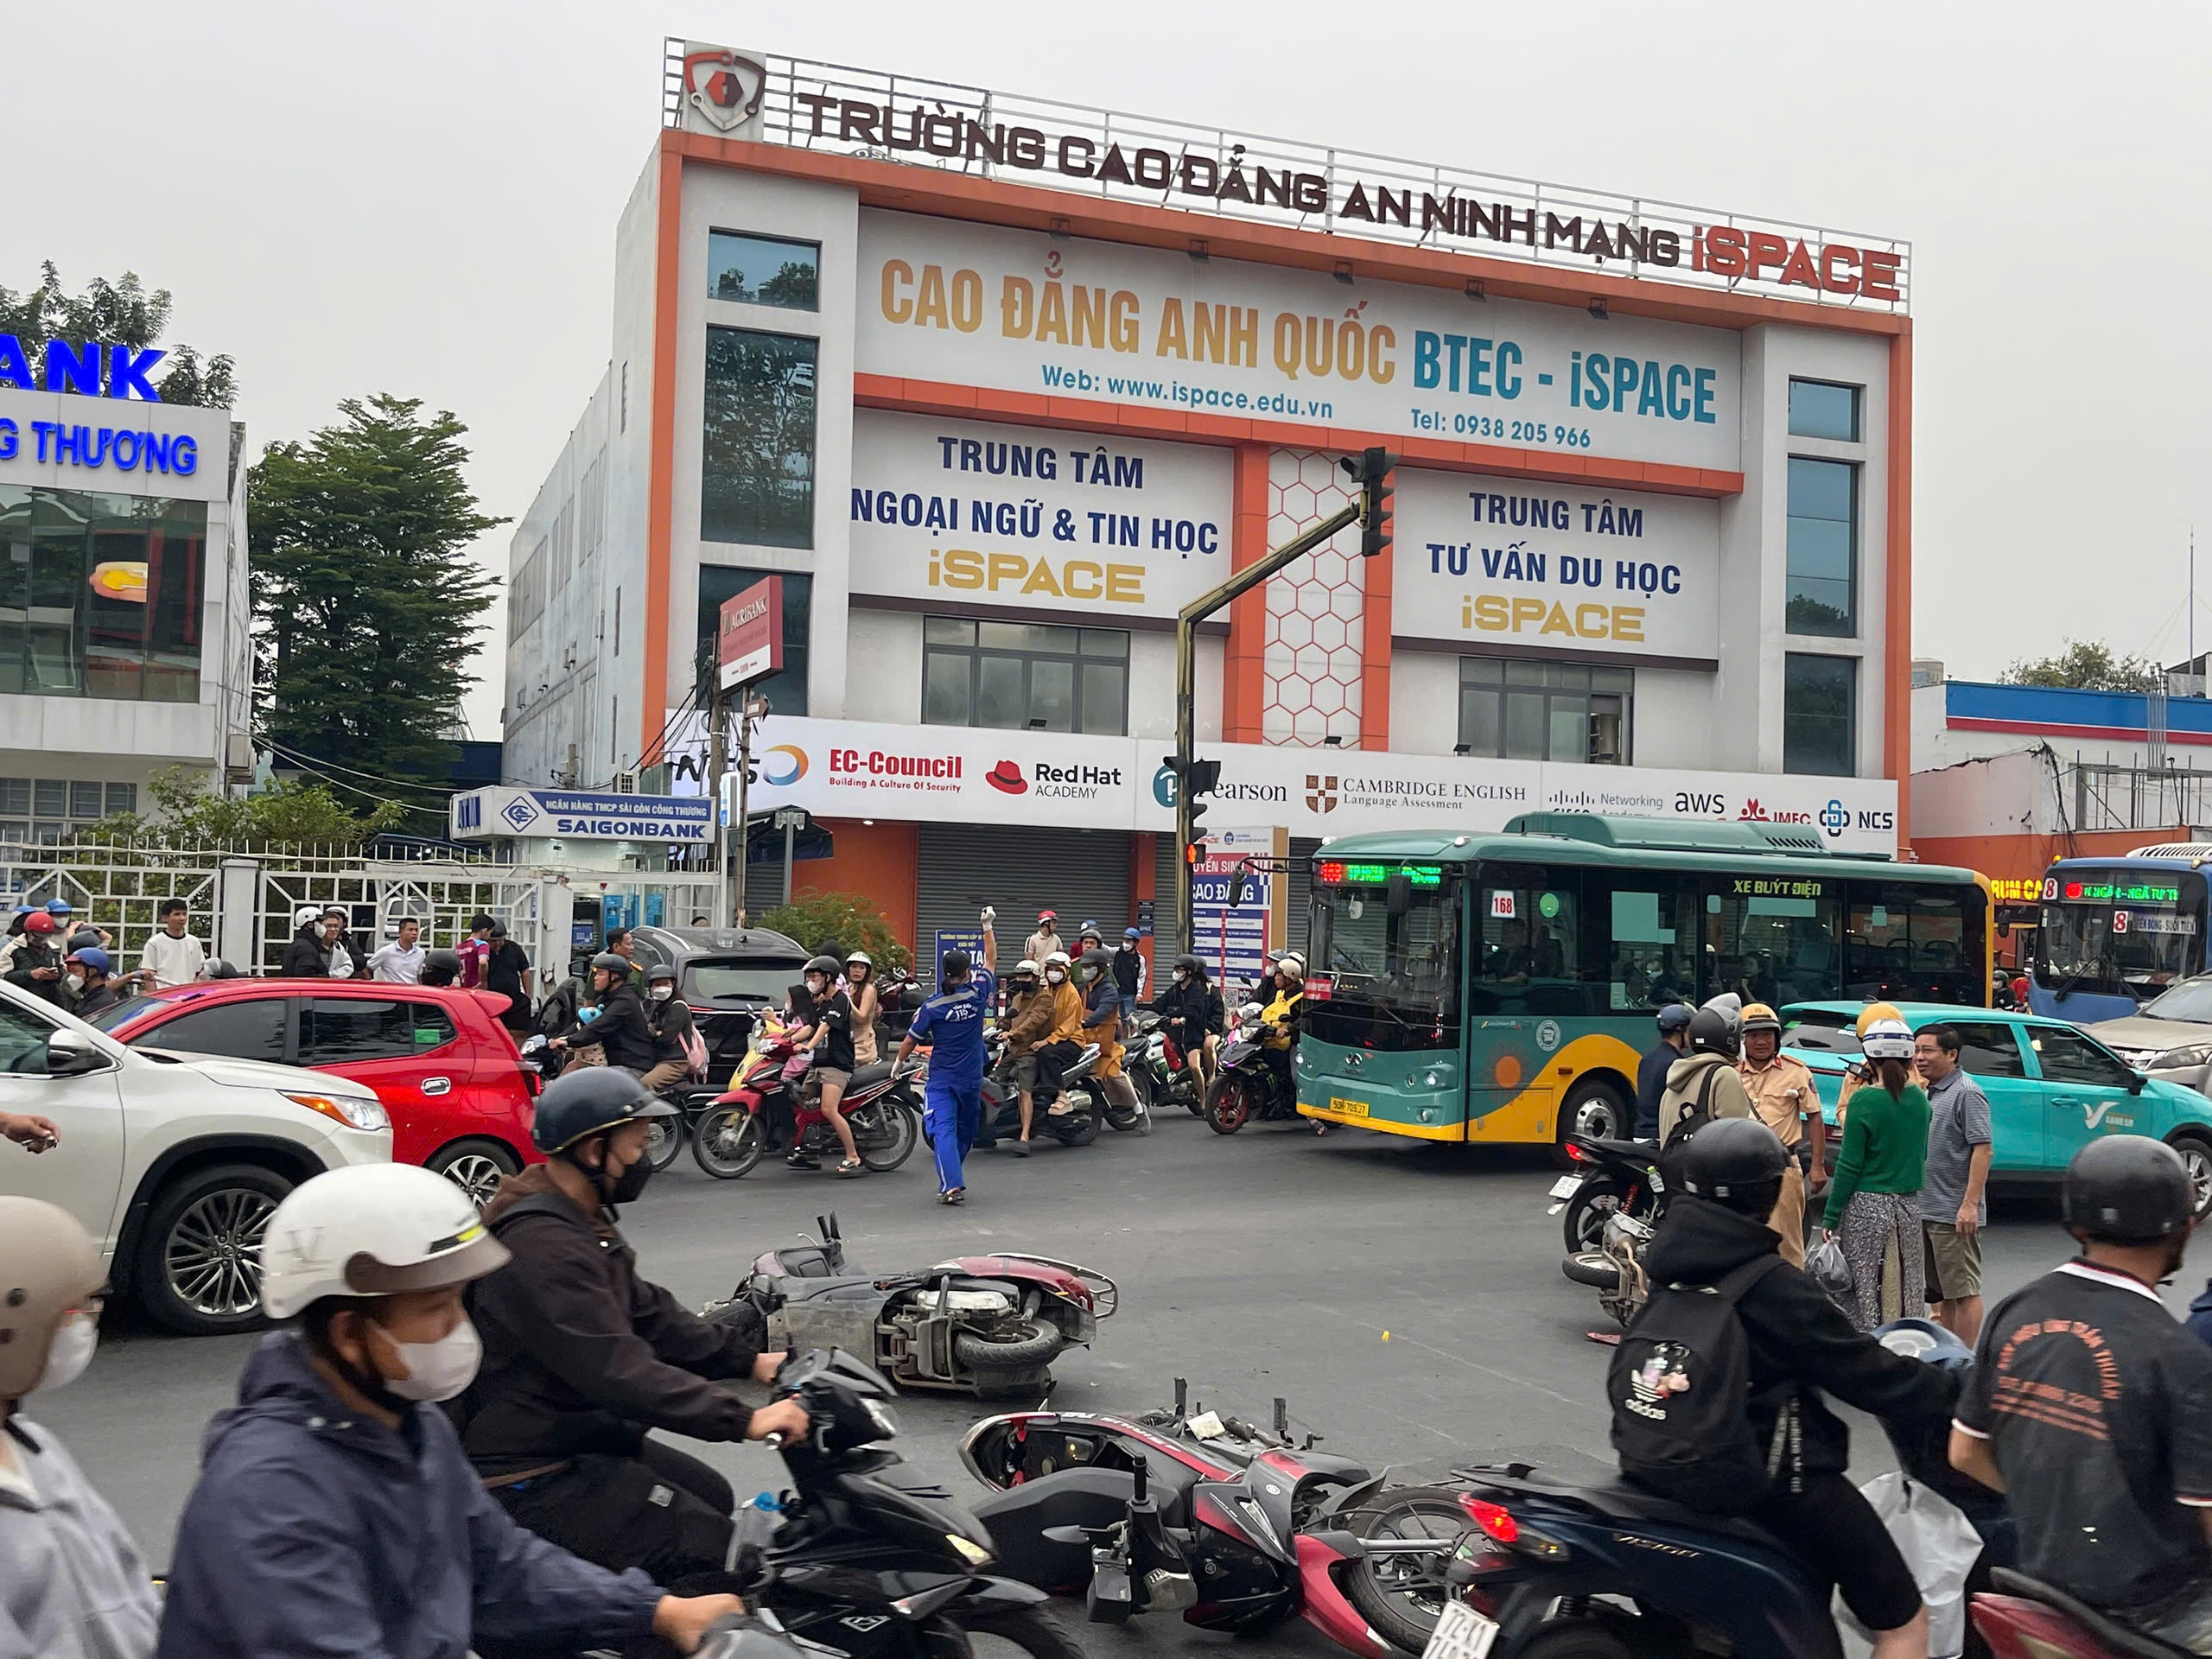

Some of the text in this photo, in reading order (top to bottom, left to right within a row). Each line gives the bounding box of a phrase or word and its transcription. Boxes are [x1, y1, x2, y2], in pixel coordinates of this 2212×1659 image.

[798, 92, 1901, 302] TRƯỜNG CAO ĐẲNG AN NINH MẠNG iSPACE
[880, 258, 983, 334] CAO
[1001, 251, 1141, 354] ĐẲNG
[1156, 296, 1259, 370] ANH
[1274, 301, 1396, 385] QUỐC
[1413, 329, 1523, 401] BTEC
[1570, 350, 1717, 425] iSPACE
[0, 334, 168, 403] ANK
[1040, 365, 1334, 420] Web: www.ispace.edu.vn
[1411, 408, 1592, 449] Tel: 0938 205 966
[31, 420, 198, 476] THƯƠNG
[937, 435, 1144, 490] TRUNG TÂM
[851, 488, 1219, 560] NGOẠI NGỮ & TIN HỌC
[1469, 492, 1643, 538] TRUNG TÂM
[928, 549, 1147, 605] iSPACE
[1426, 541, 1681, 600] TƯ VẤN DU HỌC
[1461, 594, 1646, 643] iSPACE
[830, 748, 963, 779] EC-Council
[1035, 763, 1122, 787] Red Hat
[829, 778, 963, 793] Building A Culture Of Security
[1035, 785, 1098, 799] ACADEMY
[1197, 779, 1287, 802] earson
[1343, 778, 1527, 801] CAMBRIDGE ENGLISH
[546, 798, 707, 817] NGÂN HÀNG TMCP SÀI GÒN CÔNG THƯƠNG
[1344, 793, 1464, 810] Language Assessment
[1600, 792, 1664, 811] Networking
[1674, 791, 1726, 815] aws
[557, 819, 707, 839] SAIGONBANK
[1858, 810, 1894, 830] NCS
[1193, 855, 1218, 873] UYỂN
[1732, 880, 1752, 893] XE
[1754, 878, 1790, 895] BUÝT
[2046, 879, 2056, 899] 8
[1494, 895, 1513, 914] 168
[2113, 912, 2126, 931] 8
[969, 950, 986, 968] TẠ
